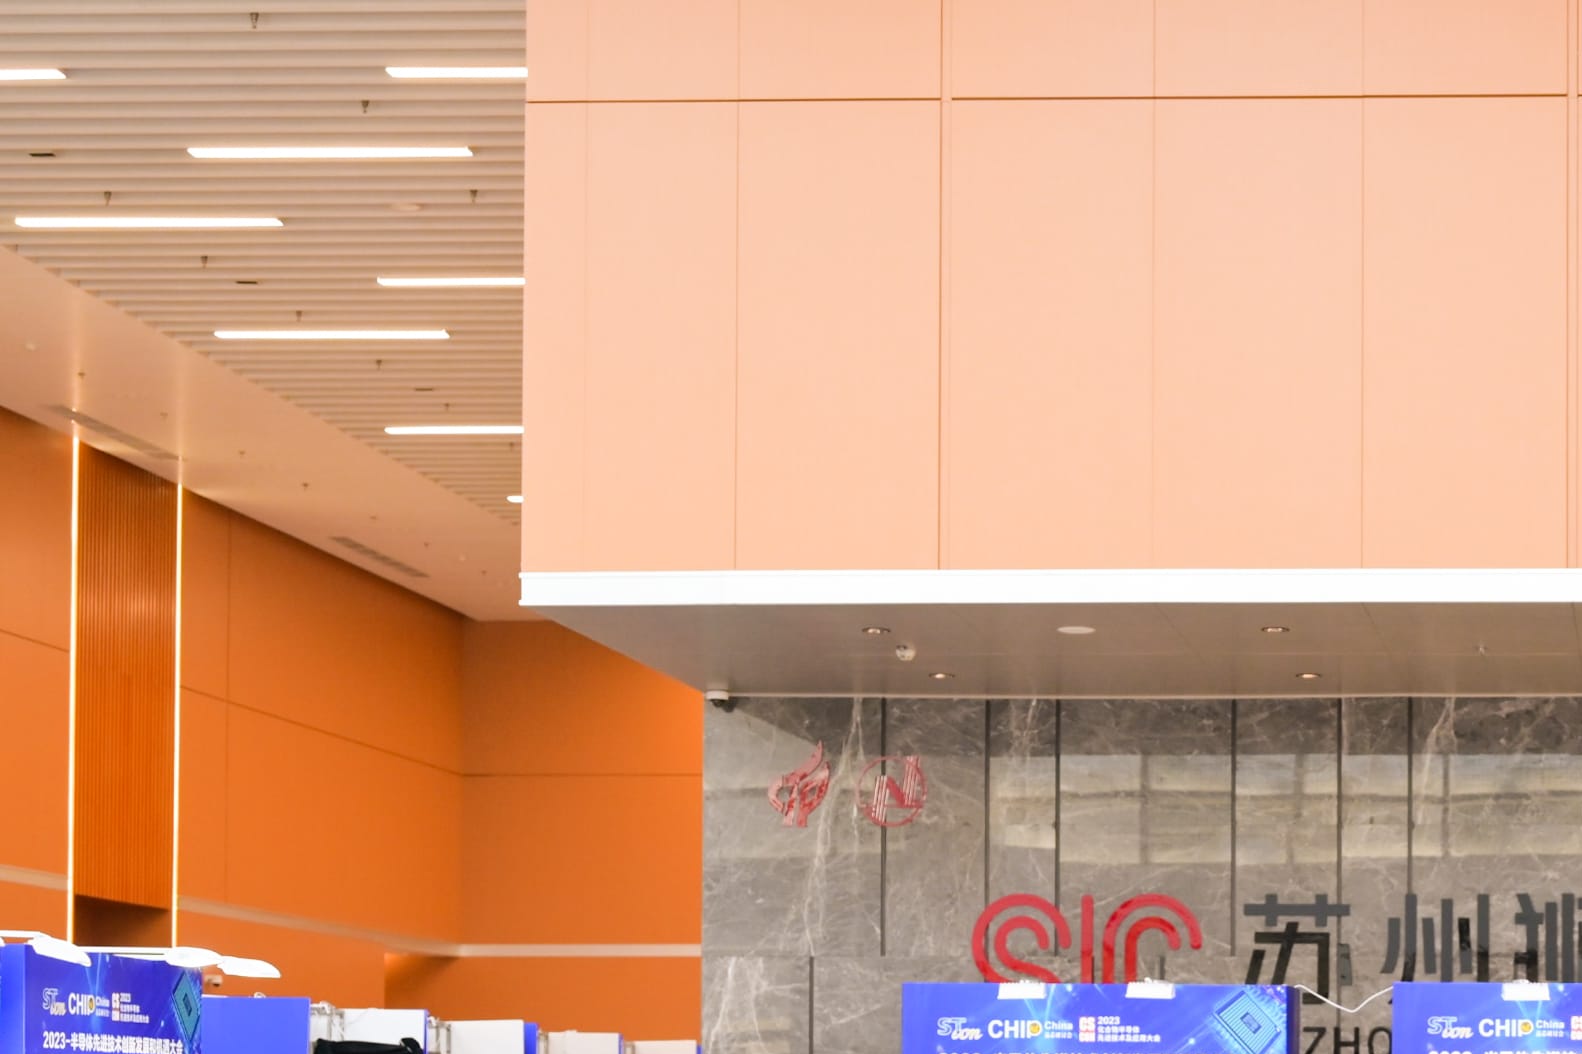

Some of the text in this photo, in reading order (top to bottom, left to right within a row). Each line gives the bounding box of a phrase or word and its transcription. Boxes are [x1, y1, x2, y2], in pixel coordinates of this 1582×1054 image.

[987, 1019, 1043, 1039] CHIP
[1044, 1021, 1073, 1031] China
[1098, 1016, 1120, 1025] 2023
[1478, 1018, 1534, 1038] CHIP
[1536, 1020, 1564, 1029] China
